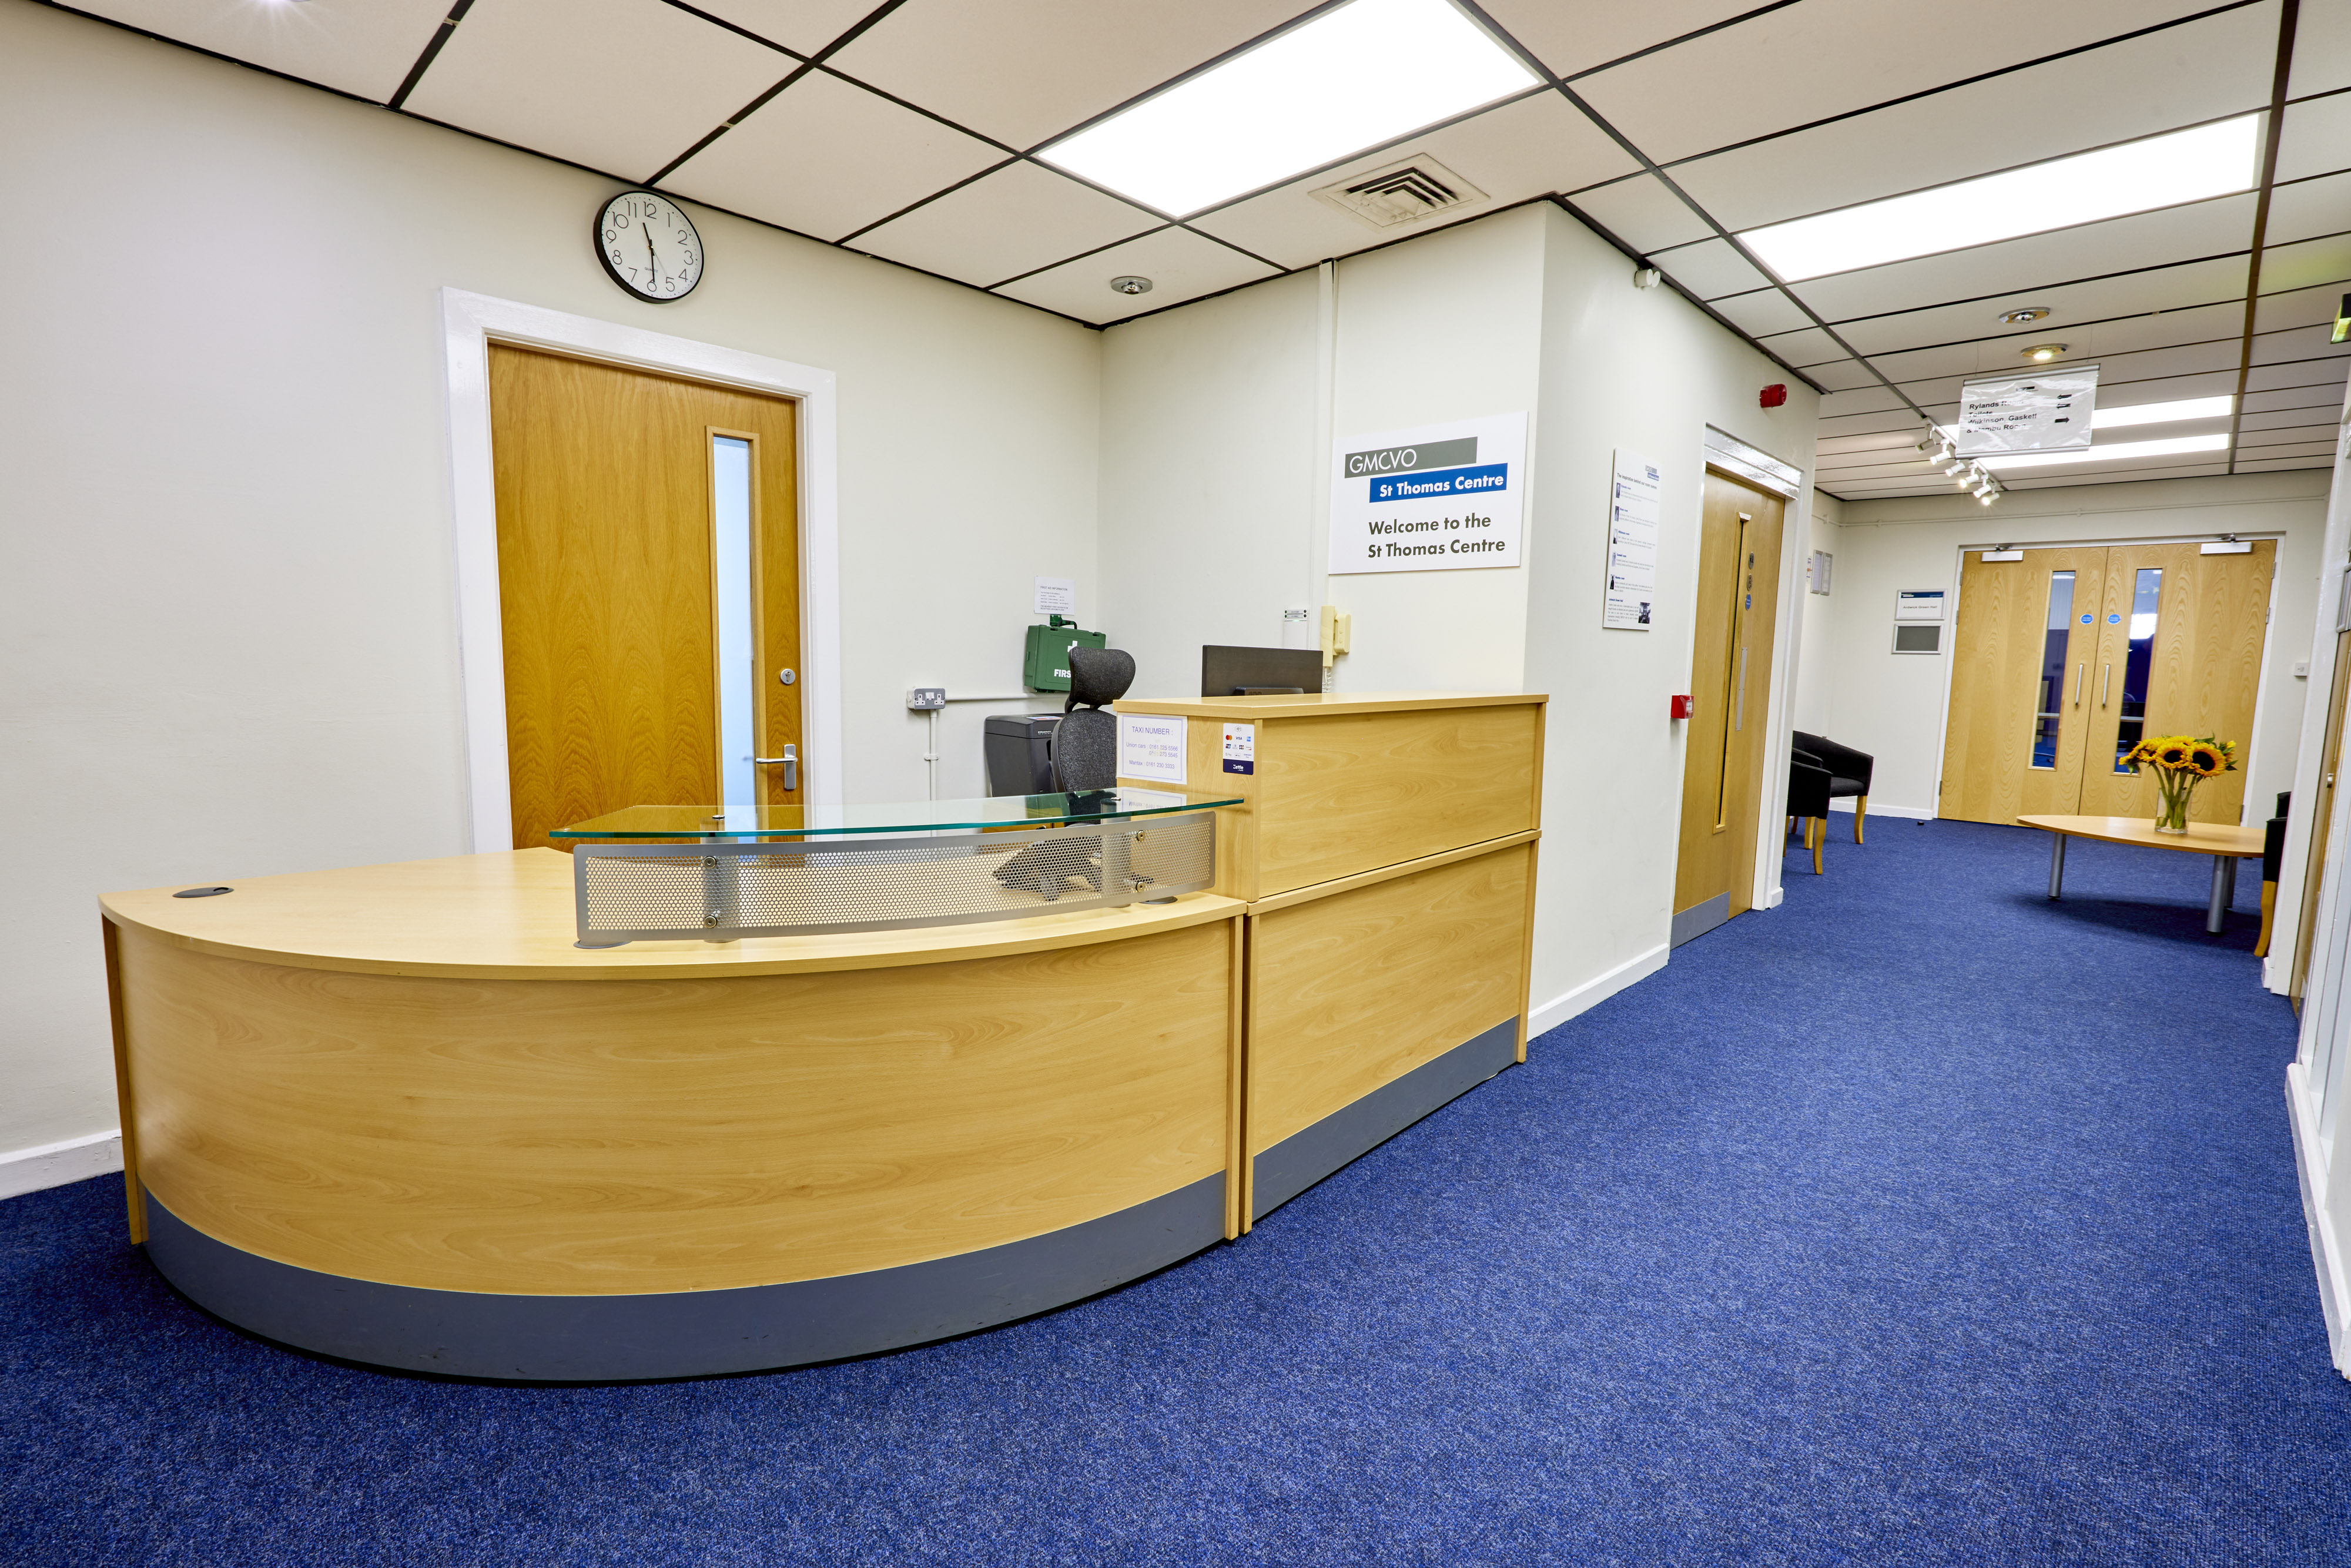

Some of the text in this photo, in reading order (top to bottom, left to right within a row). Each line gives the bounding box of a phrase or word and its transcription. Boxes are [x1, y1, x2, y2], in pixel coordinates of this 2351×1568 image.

[627, 201, 637, 218] 11
[644, 201, 657, 219] 12
[612, 212, 629, 229] 10
[667, 212, 670, 227] 1
[606, 230, 617, 244] 9
[678, 230, 688, 246] 2
[612, 250, 622, 264] 8
[684, 250, 694, 265] 3
[628, 267, 638, 282] 7
[678, 269, 688, 282] 4
[647, 279, 657, 292] 6
[666, 277, 675, 292] 5
[1969, 402, 1999, 410] Rylands
[1349, 448, 1417, 474] GMCVO
[1379, 475, 1504, 498] St Thomas Centre
[1368, 512, 1492, 535] Welcome to the
[1368, 539, 1506, 558] St Thomas Centre
[1054, 669, 1071, 678] FIRS
[1145, 727, 1170, 735] NUMBER
